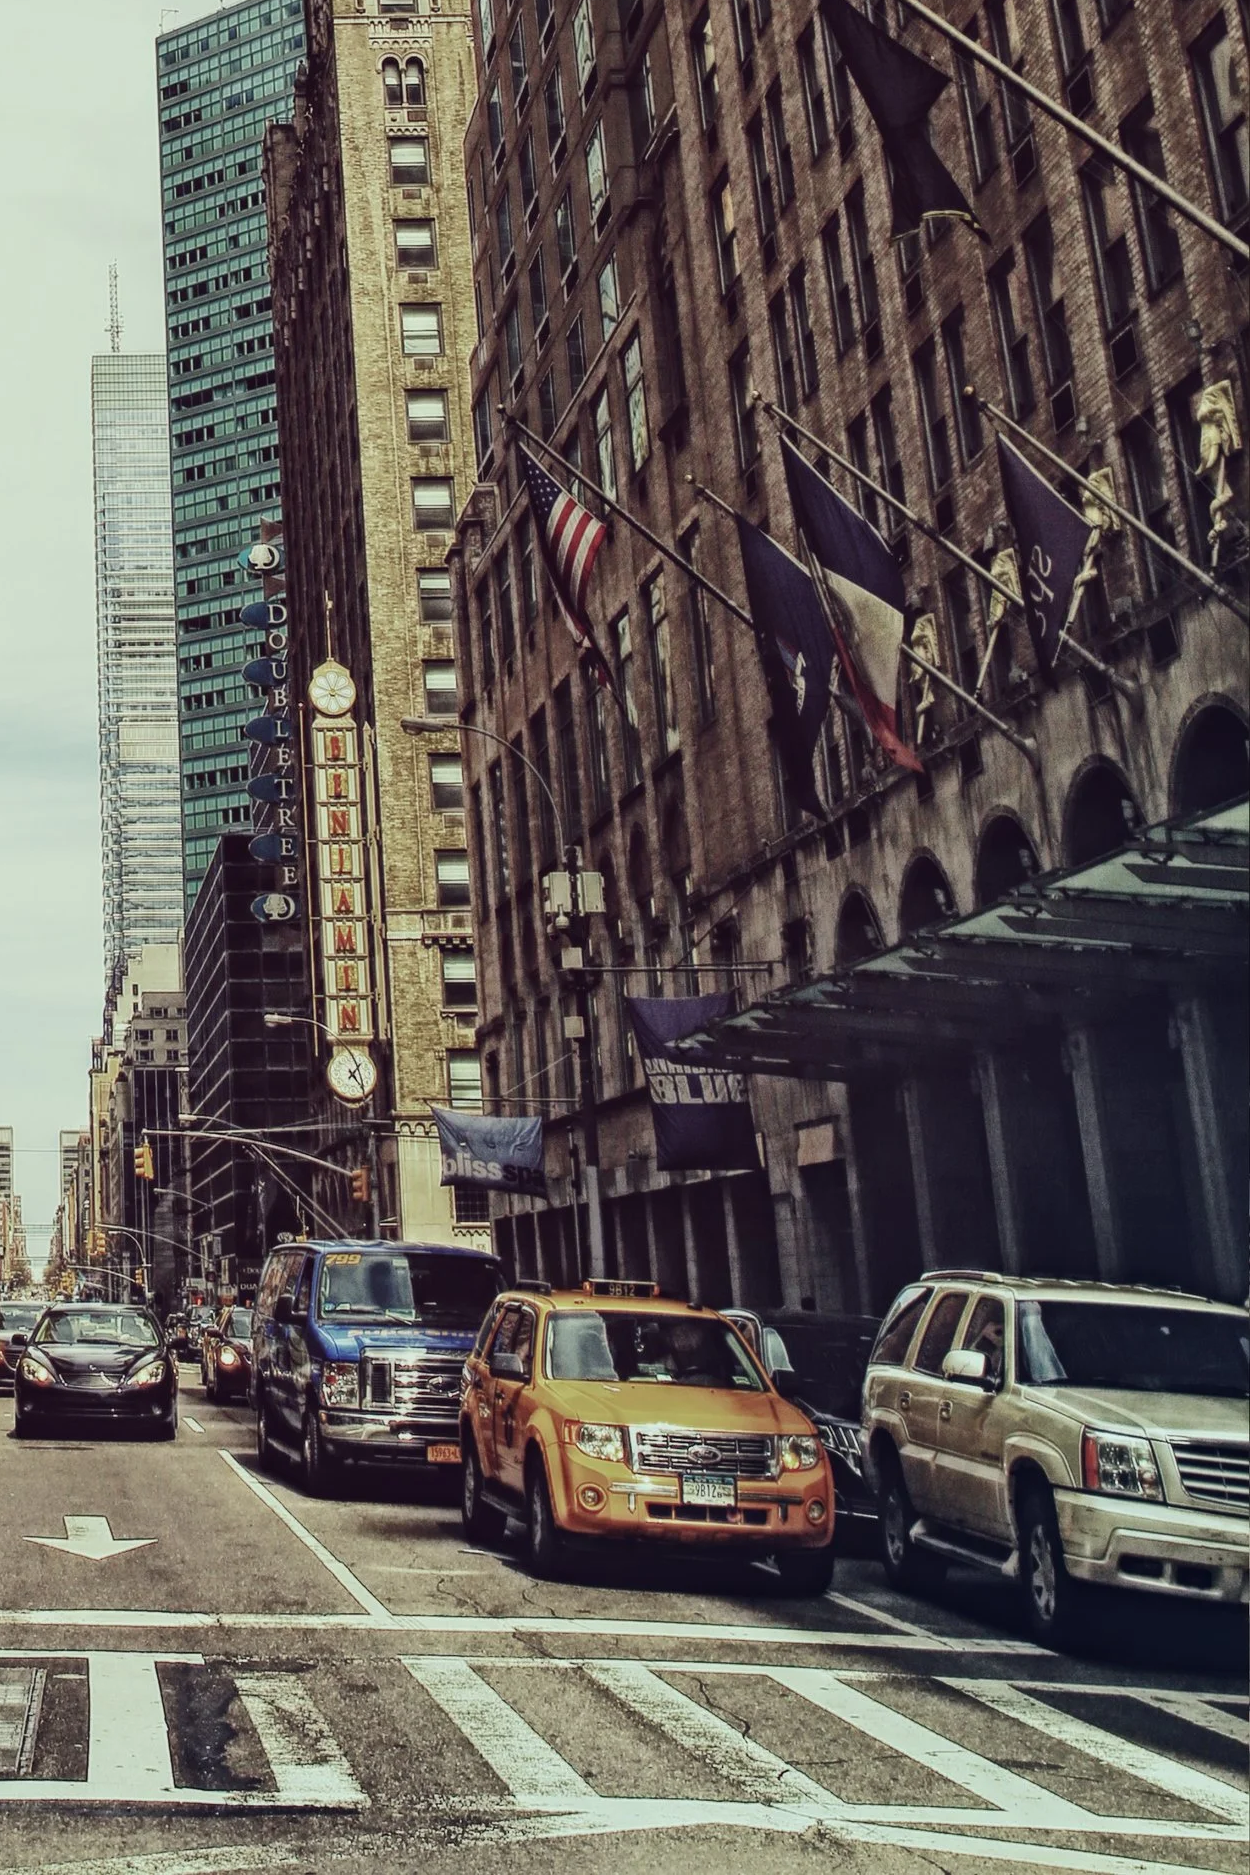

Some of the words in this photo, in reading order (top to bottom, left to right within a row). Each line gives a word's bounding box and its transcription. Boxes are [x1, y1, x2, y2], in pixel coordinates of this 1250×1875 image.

[267, 603, 298, 885] DOUBLETREE
[330, 735, 358, 1031] BENJAMIN
[325, 1254, 361, 1265] 799
[609, 1284, 635, 1296] 9B12
